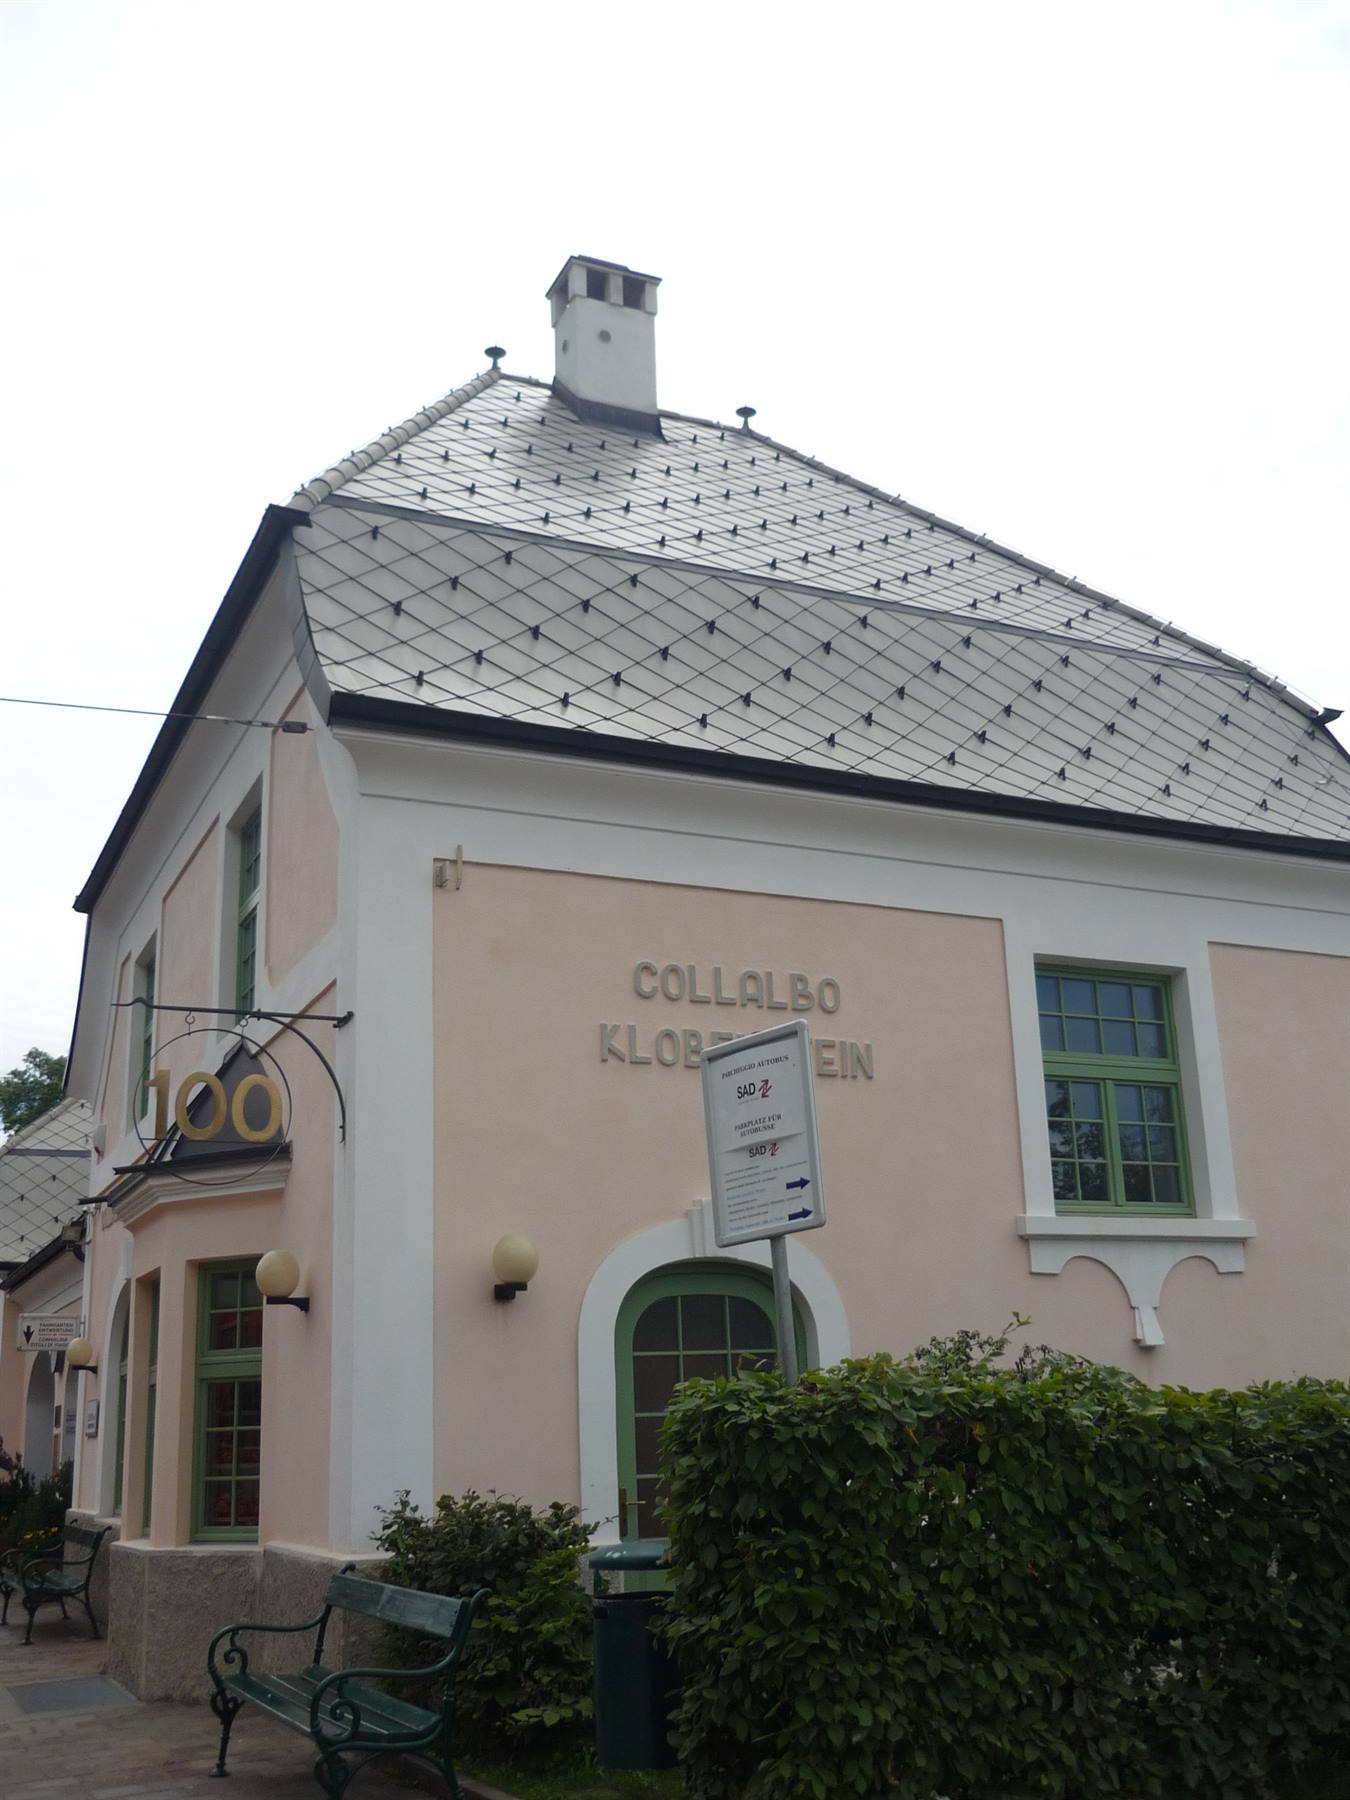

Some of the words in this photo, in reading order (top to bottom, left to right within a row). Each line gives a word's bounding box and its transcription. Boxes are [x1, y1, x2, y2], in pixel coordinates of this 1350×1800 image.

[633, 960, 841, 1013] COLLALBO
[600, 1022, 874, 1079] KLOBEIN
[757, 1055, 789, 1068] AUTOBUS
[737, 1082, 756, 1100] SAD
[143, 1069, 283, 1142] 100
[734, 1116, 767, 1131] PARKPLATZ
[740, 1123, 776, 1137] AUTOBUSSE
[749, 1145, 767, 1158] SAD
